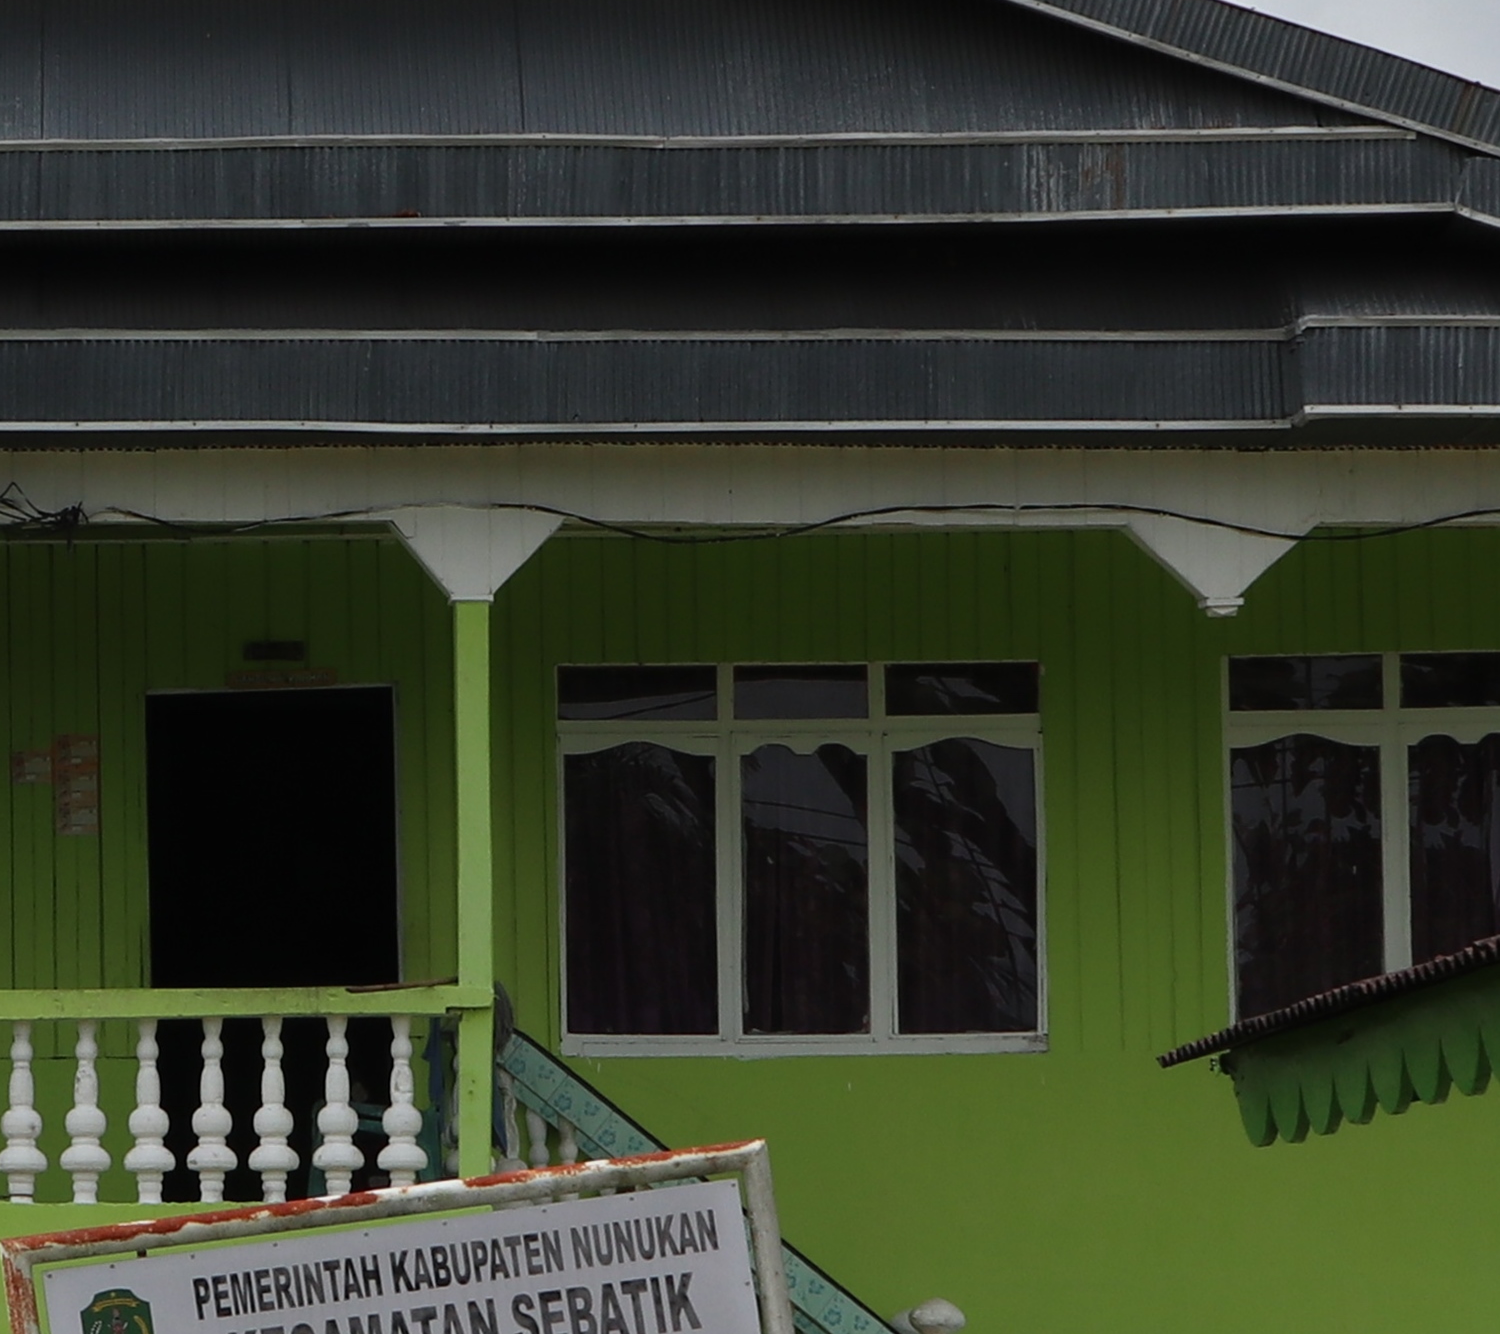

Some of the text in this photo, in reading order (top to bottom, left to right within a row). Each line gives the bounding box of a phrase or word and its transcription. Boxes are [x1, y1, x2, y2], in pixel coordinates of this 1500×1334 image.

[193, 1209, 718, 1321] PEMERINTAH KABUPATEN NUNUKAN
